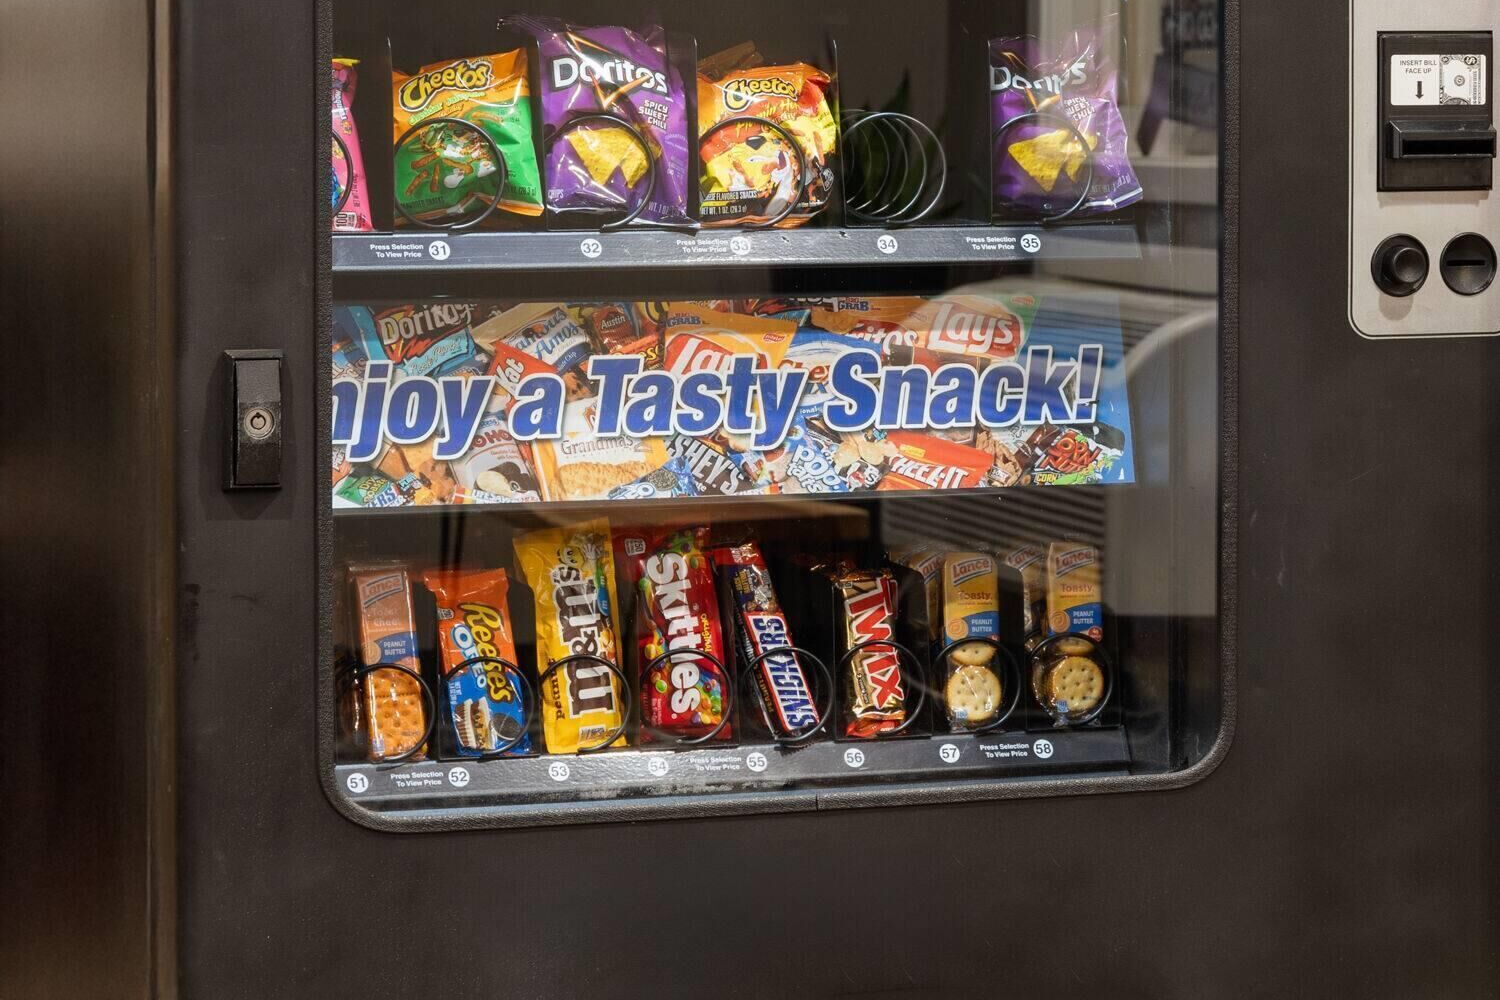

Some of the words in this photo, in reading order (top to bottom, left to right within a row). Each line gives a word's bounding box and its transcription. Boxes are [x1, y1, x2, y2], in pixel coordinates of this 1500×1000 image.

[1399, 59, 1423, 67] INSERT
[551, 56, 669, 95] Doritos
[989, 61, 1088, 95] Doritos
[399, 57, 494, 111] Cheetos
[722, 77, 799, 112] Cheetos
[643, 99, 669, 113] SPICY
[638, 106, 669, 122] SWEET
[646, 116, 668, 129] CHILI
[430, 243, 448, 257] 31
[582, 240, 600, 255] 32
[731, 238, 749, 252] 33
[878, 237, 896, 251] 34
[1021, 237, 1040, 250] 35
[600, 315, 626, 330] Austin
[508, 372, 566, 441] a
[587, 353, 809, 451] Tasty
[824, 343, 1103, 432] Snack!
[952, 558, 990, 578] Lance
[644, 550, 704, 715] Skittles
[845, 576, 905, 710] TWIX
[457, 602, 513, 703] Reese's
[940, 747, 958, 759] 57
[1034, 742, 1052, 755] 58
[747, 755, 767, 769] 55
[846, 751, 863, 764] 56
[550, 764, 568, 778] 53
[649, 760, 667, 773] 54
[349, 776, 366, 789] 51
[450, 770, 469, 783] 52
